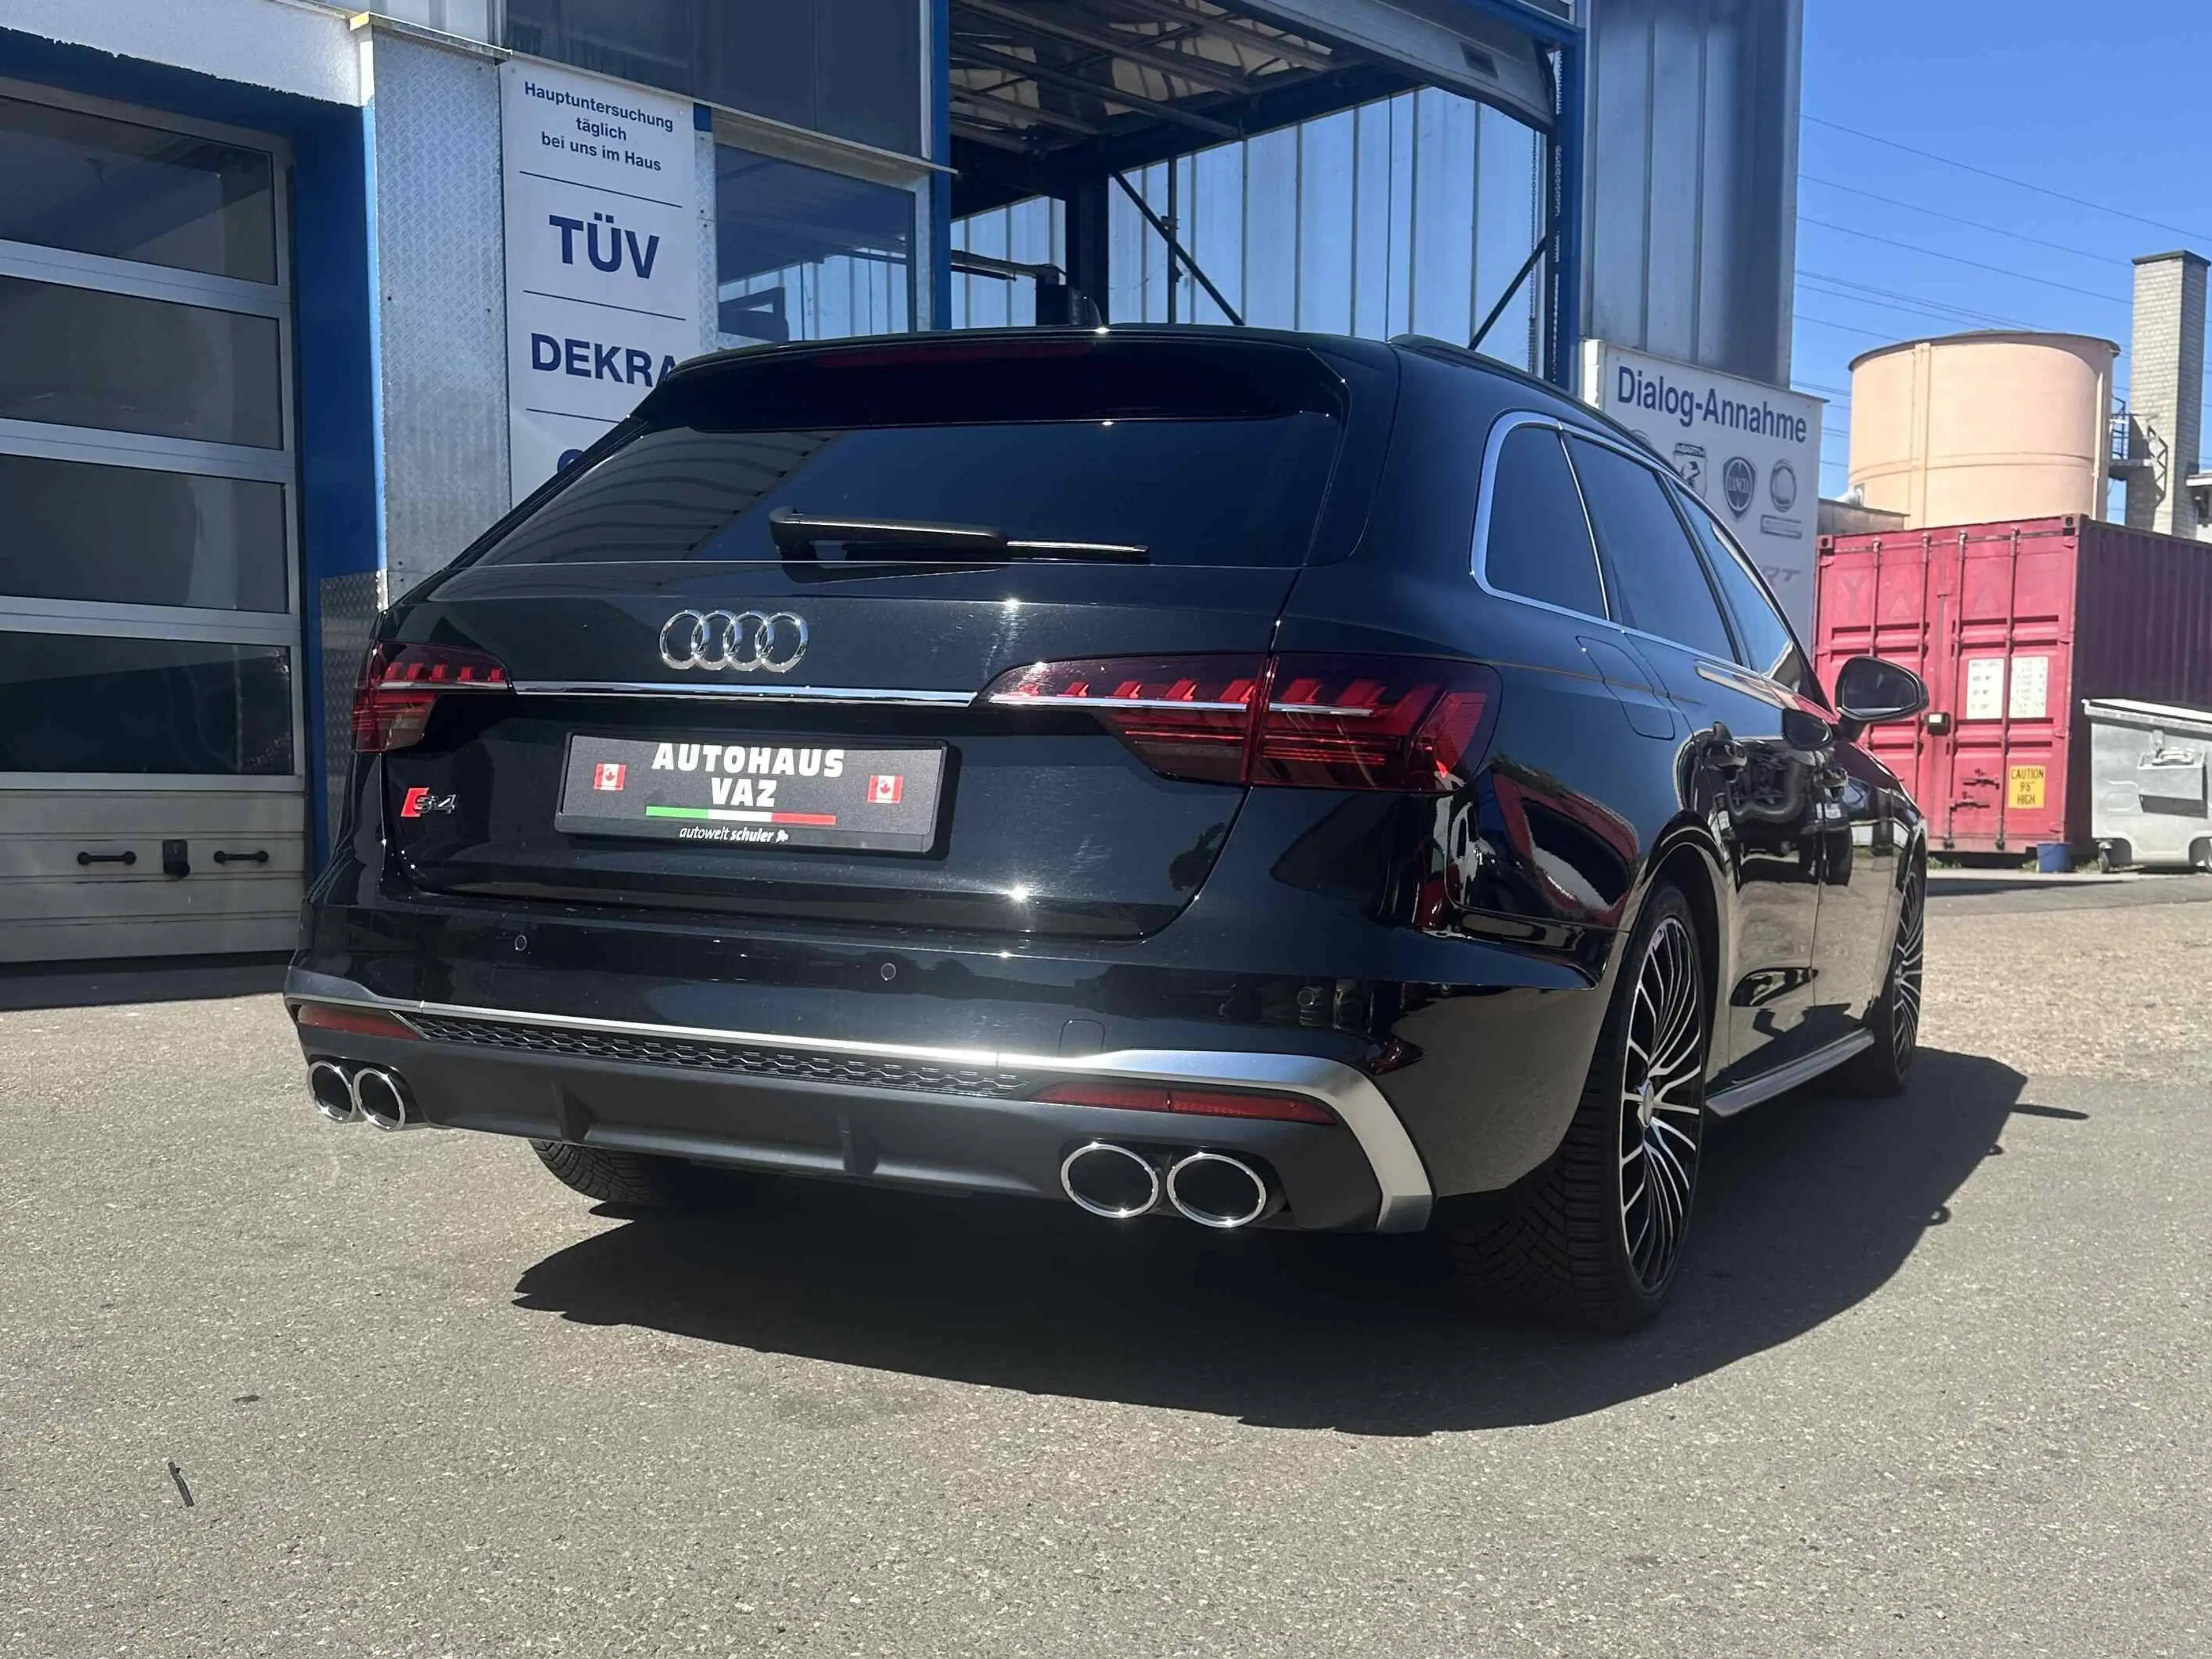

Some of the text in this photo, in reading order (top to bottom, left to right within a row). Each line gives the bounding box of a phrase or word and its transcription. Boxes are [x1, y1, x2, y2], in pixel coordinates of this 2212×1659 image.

[524, 81, 674, 132] Hauptuntersuchung
[576, 117, 627, 141] täglich
[541, 132, 661, 171] bei uns im Haus
[549, 212, 660, 279] TÜV
[1617, 366, 1807, 444] Dialog-Annahme
[652, 743, 844, 778] AUTOHAUS
[2010, 768, 2044, 780] CAUTION
[711, 777, 777, 807] VAZ
[679, 826, 774, 843] autowelt schuler
